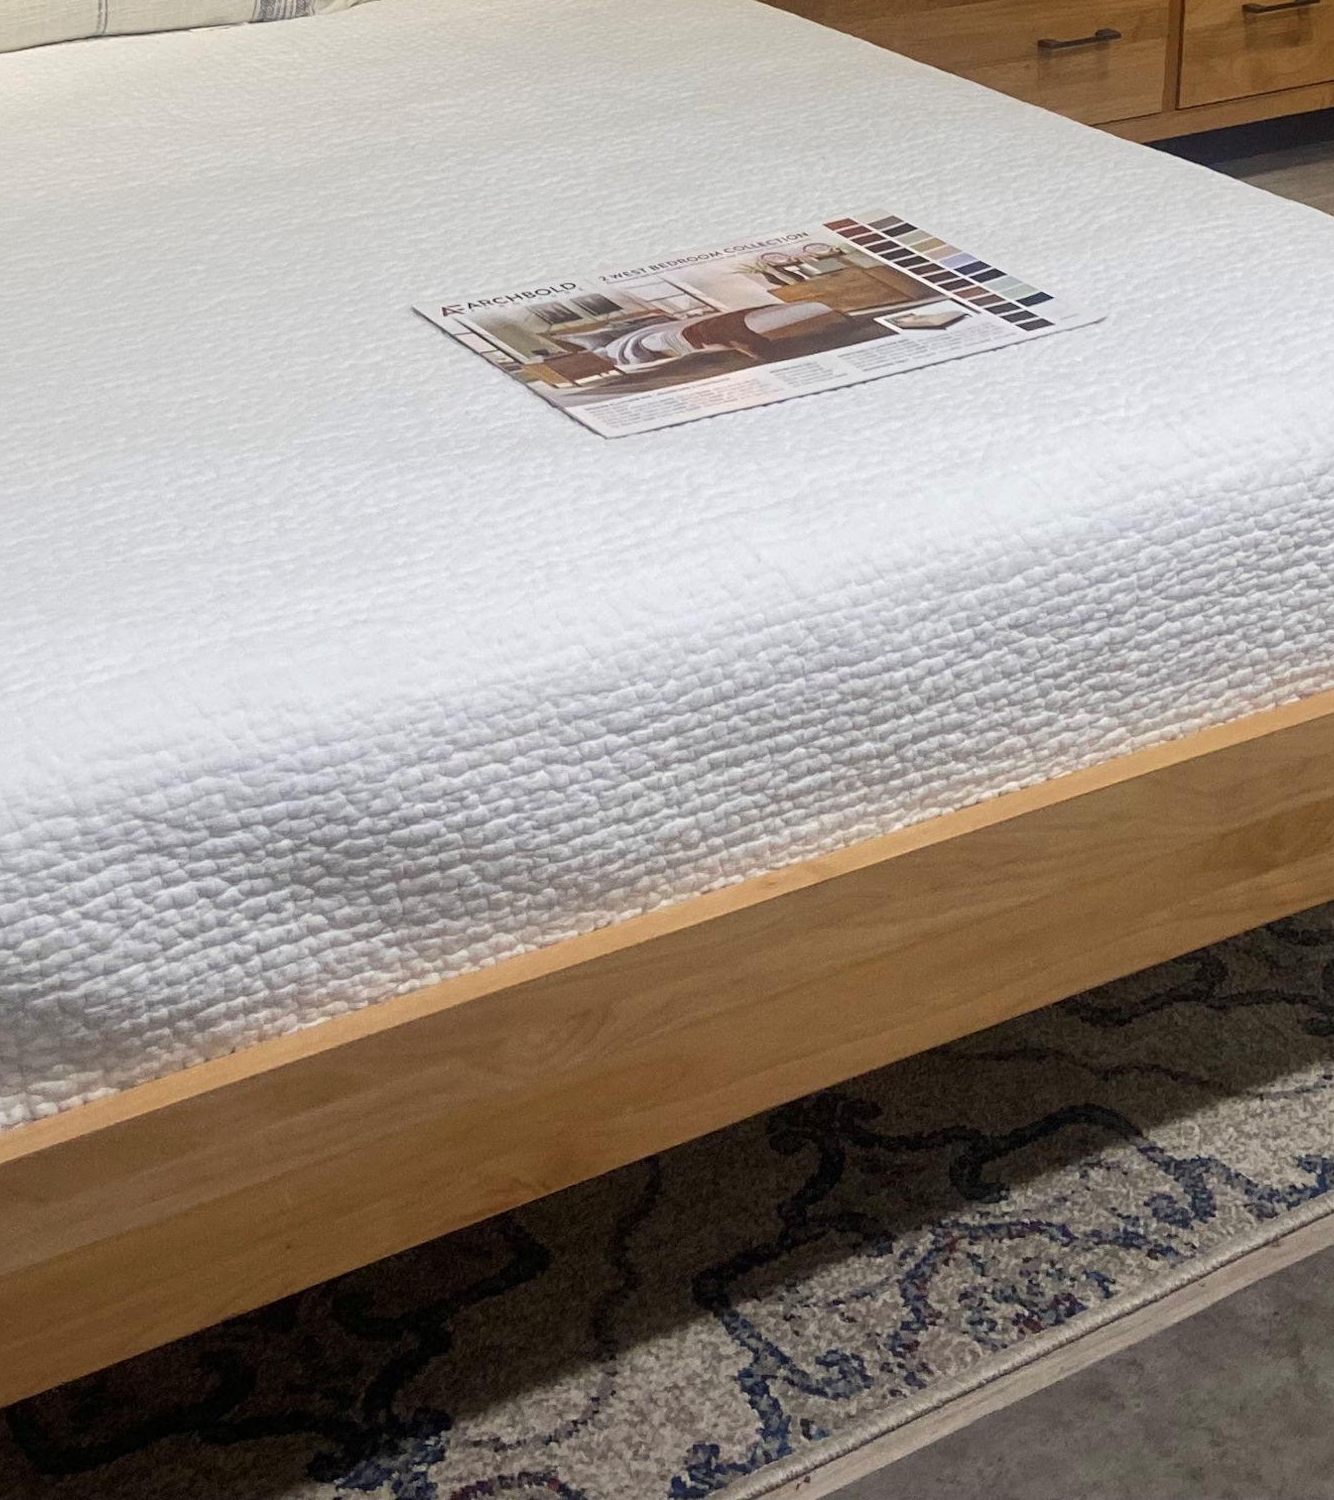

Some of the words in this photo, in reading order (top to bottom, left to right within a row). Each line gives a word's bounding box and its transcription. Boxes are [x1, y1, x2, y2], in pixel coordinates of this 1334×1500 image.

[610, 267, 647, 280] WEST
[648, 250, 722, 271] BEDROOM
[723, 231, 809, 253] COLLECTION
[467, 282, 577, 310] ARCHBOLD
